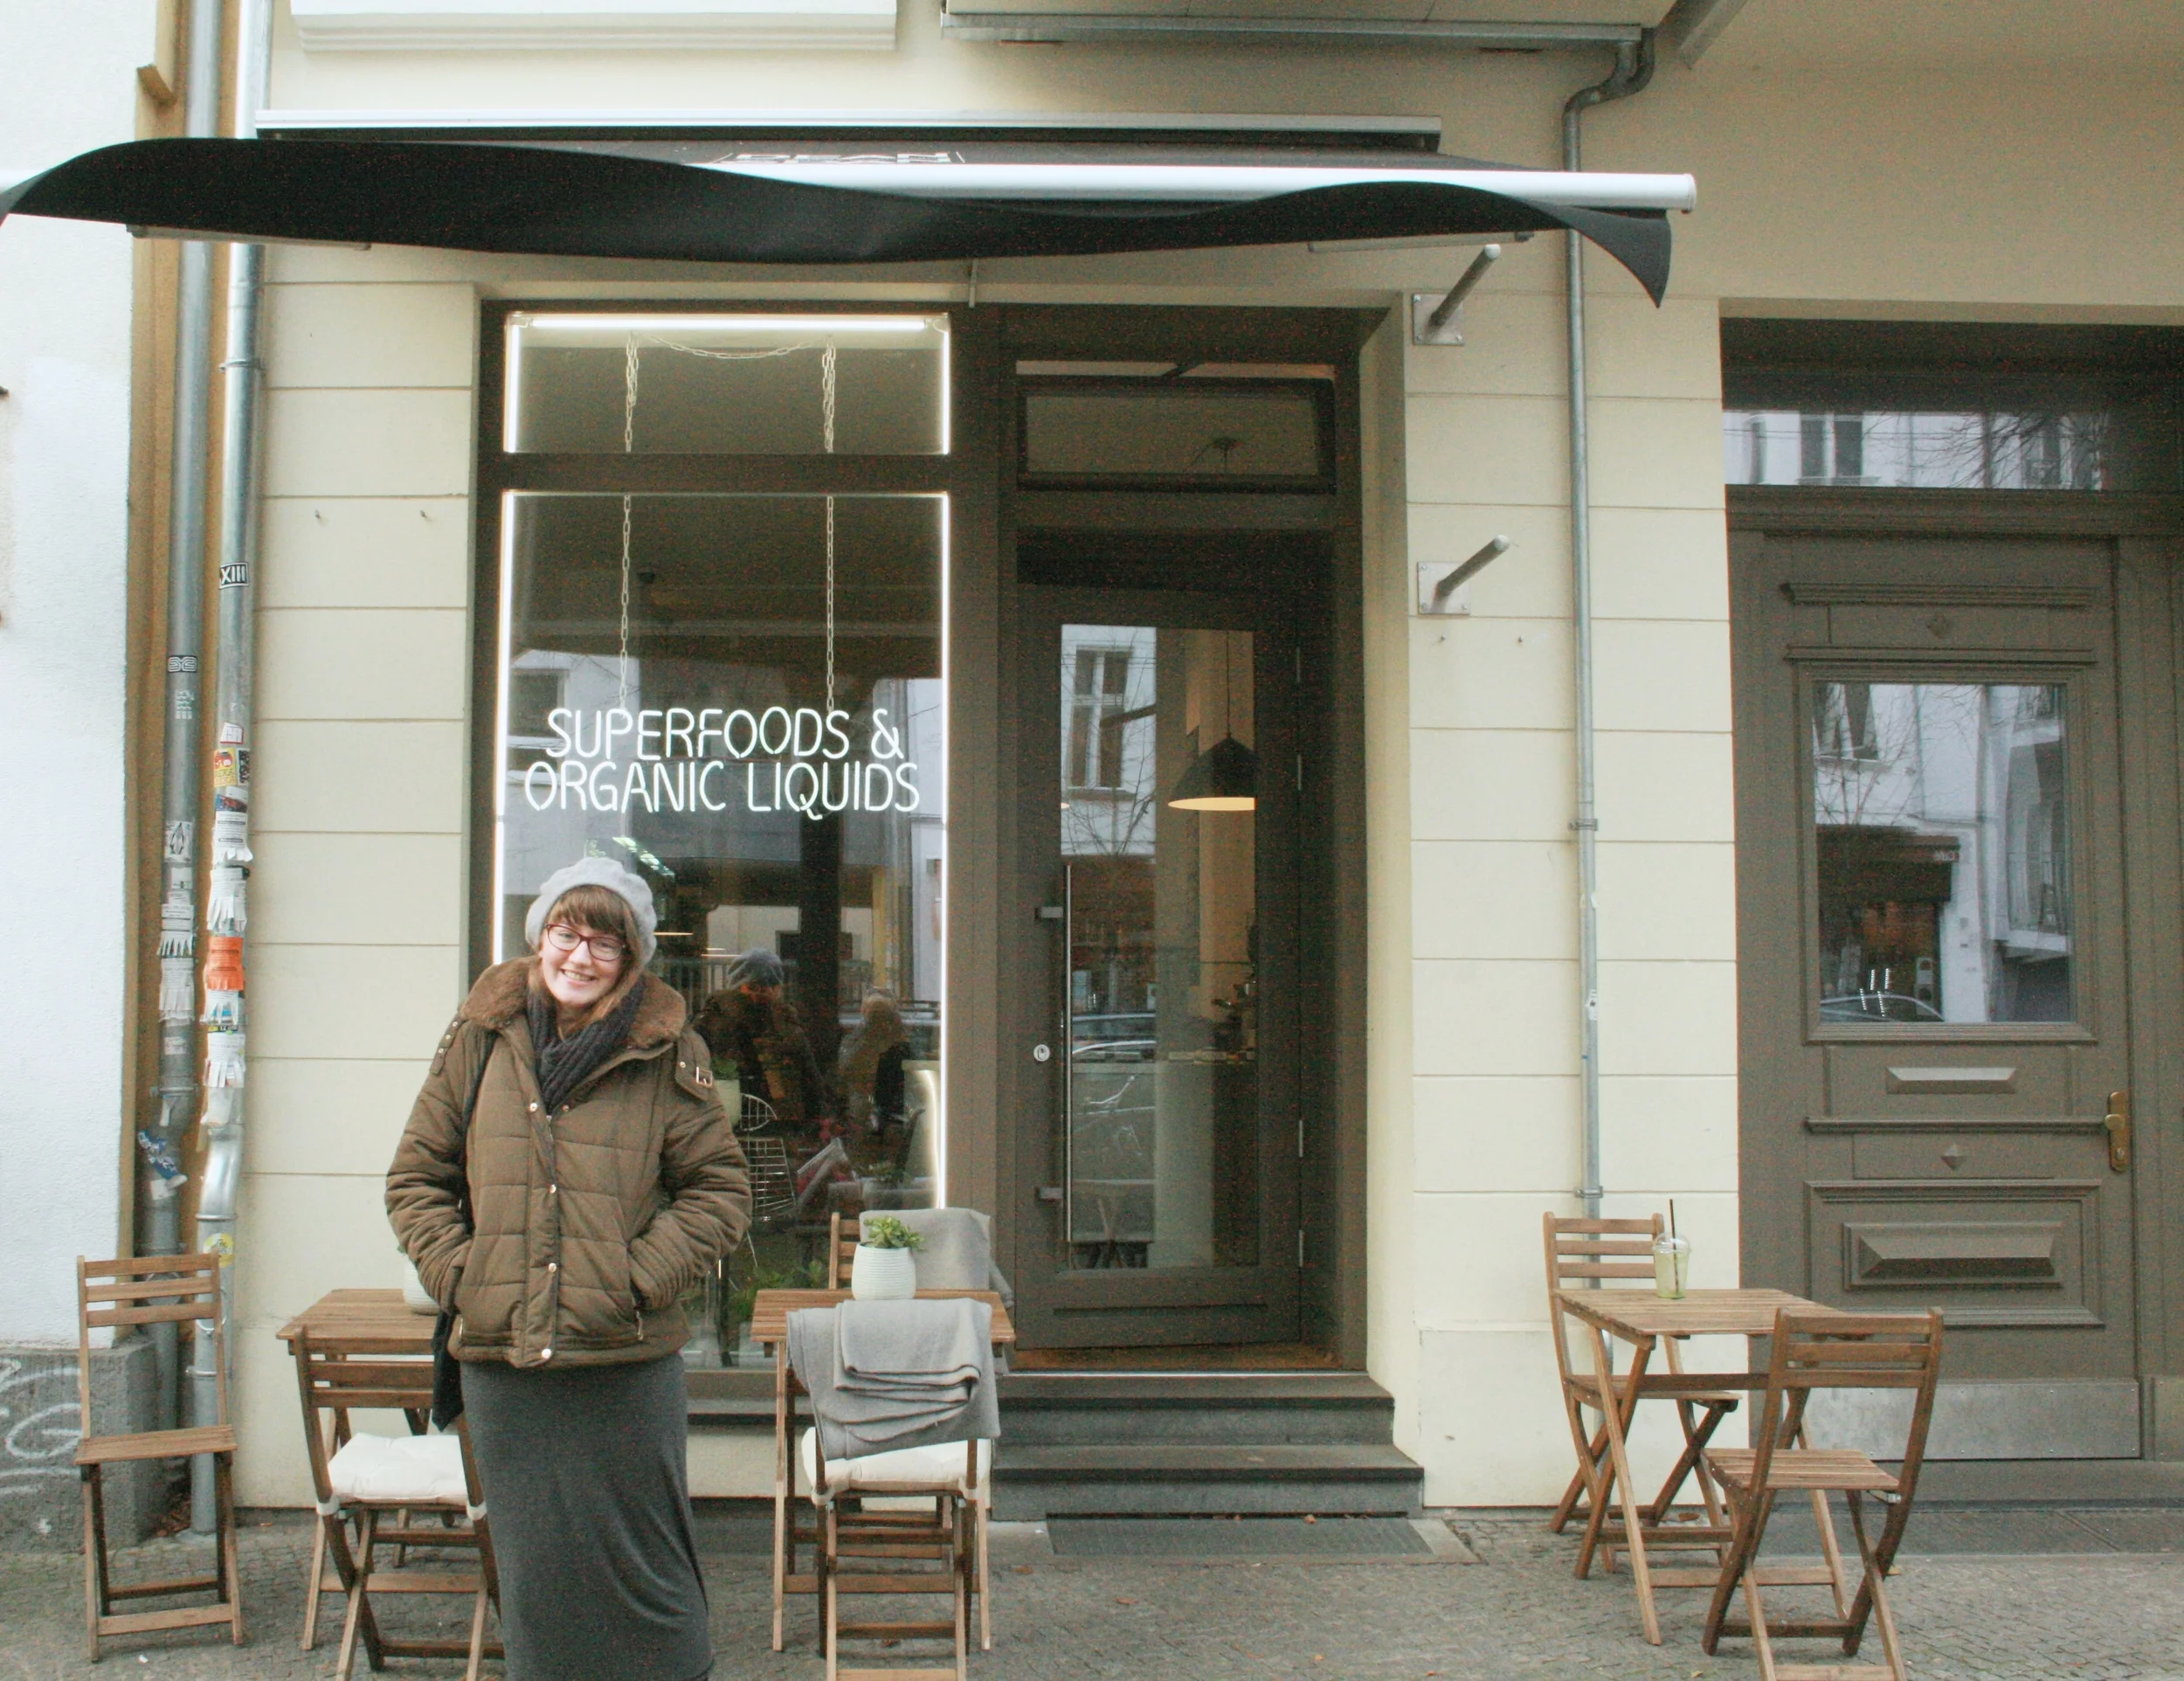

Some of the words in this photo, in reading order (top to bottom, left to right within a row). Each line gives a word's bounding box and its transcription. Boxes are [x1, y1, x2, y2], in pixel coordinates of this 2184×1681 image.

[220, 565, 245, 585] XIII
[547, 706, 850, 762] SUPERFOODS
[870, 707, 905, 760] &
[524, 760, 727, 814] ORGANIC
[748, 760, 921, 821] LIQUIDS
